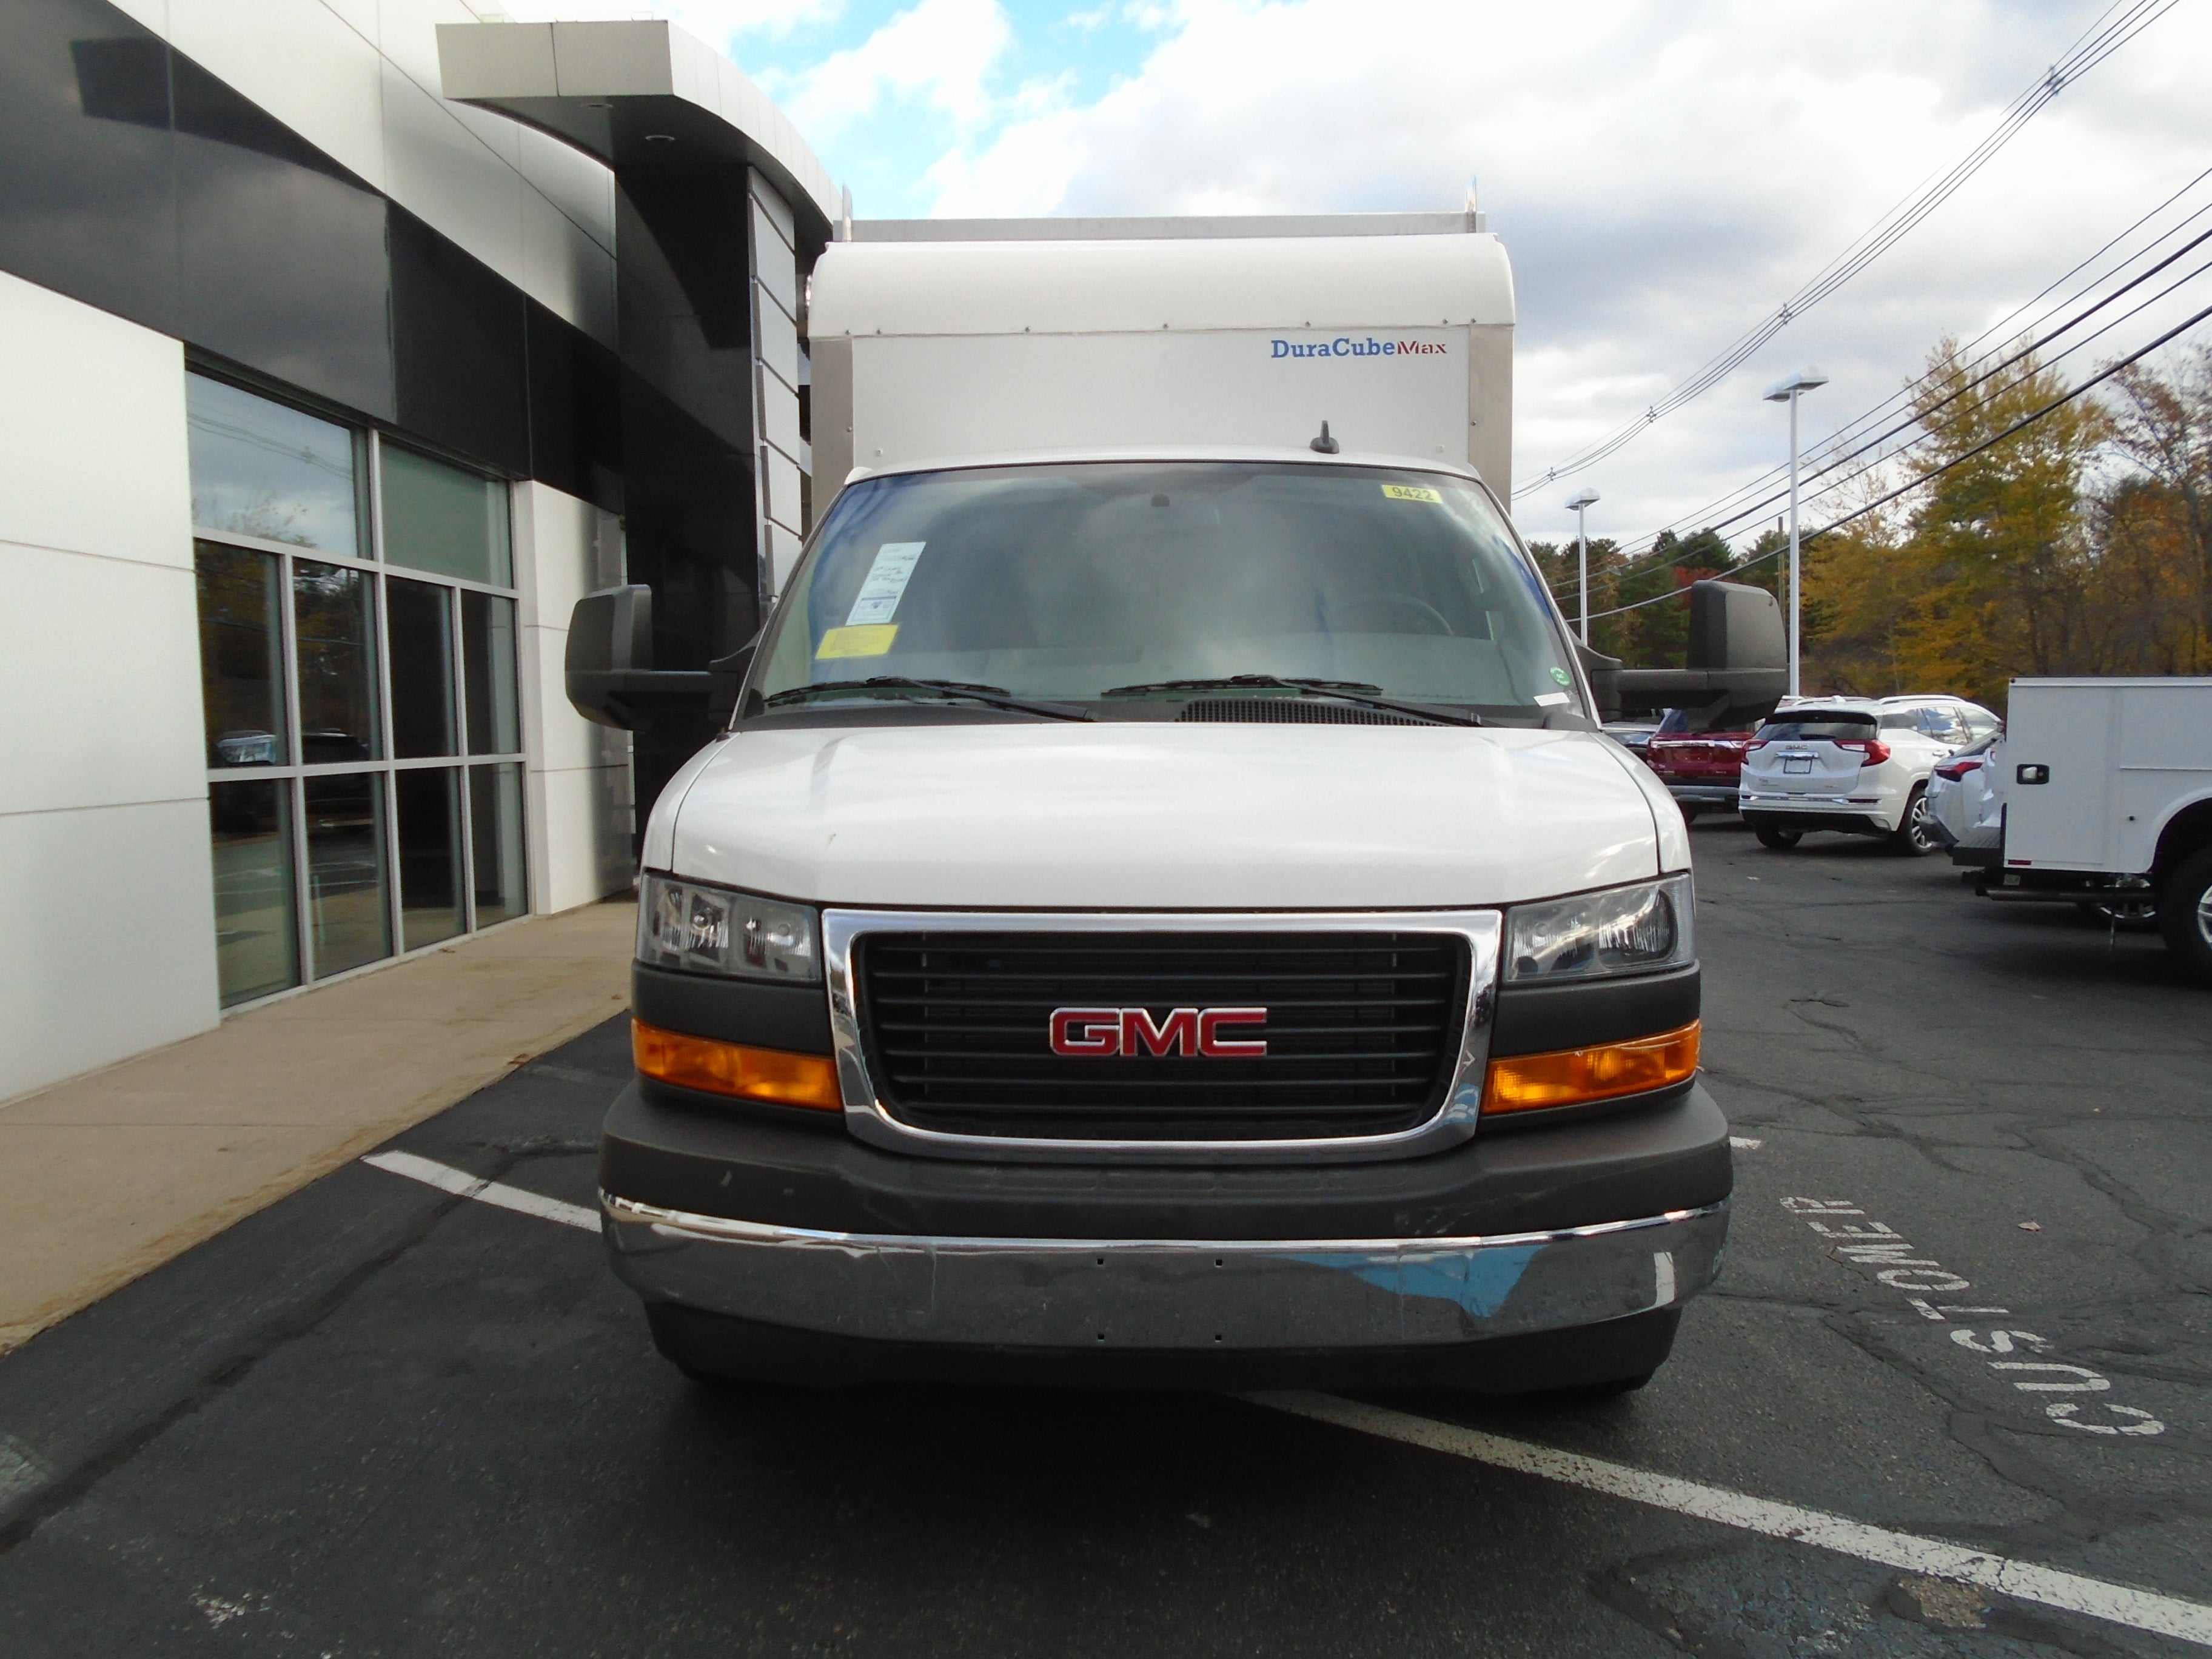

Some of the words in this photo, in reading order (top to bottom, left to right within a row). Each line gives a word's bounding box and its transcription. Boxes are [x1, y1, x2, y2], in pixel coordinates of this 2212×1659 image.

[1271, 337, 1447, 358] DuraCubeMax
[1392, 487, 1434, 500] 9422
[1050, 1007, 1267, 1057] GMC
[1779, 1197, 2165, 1436] CUSTOMER
